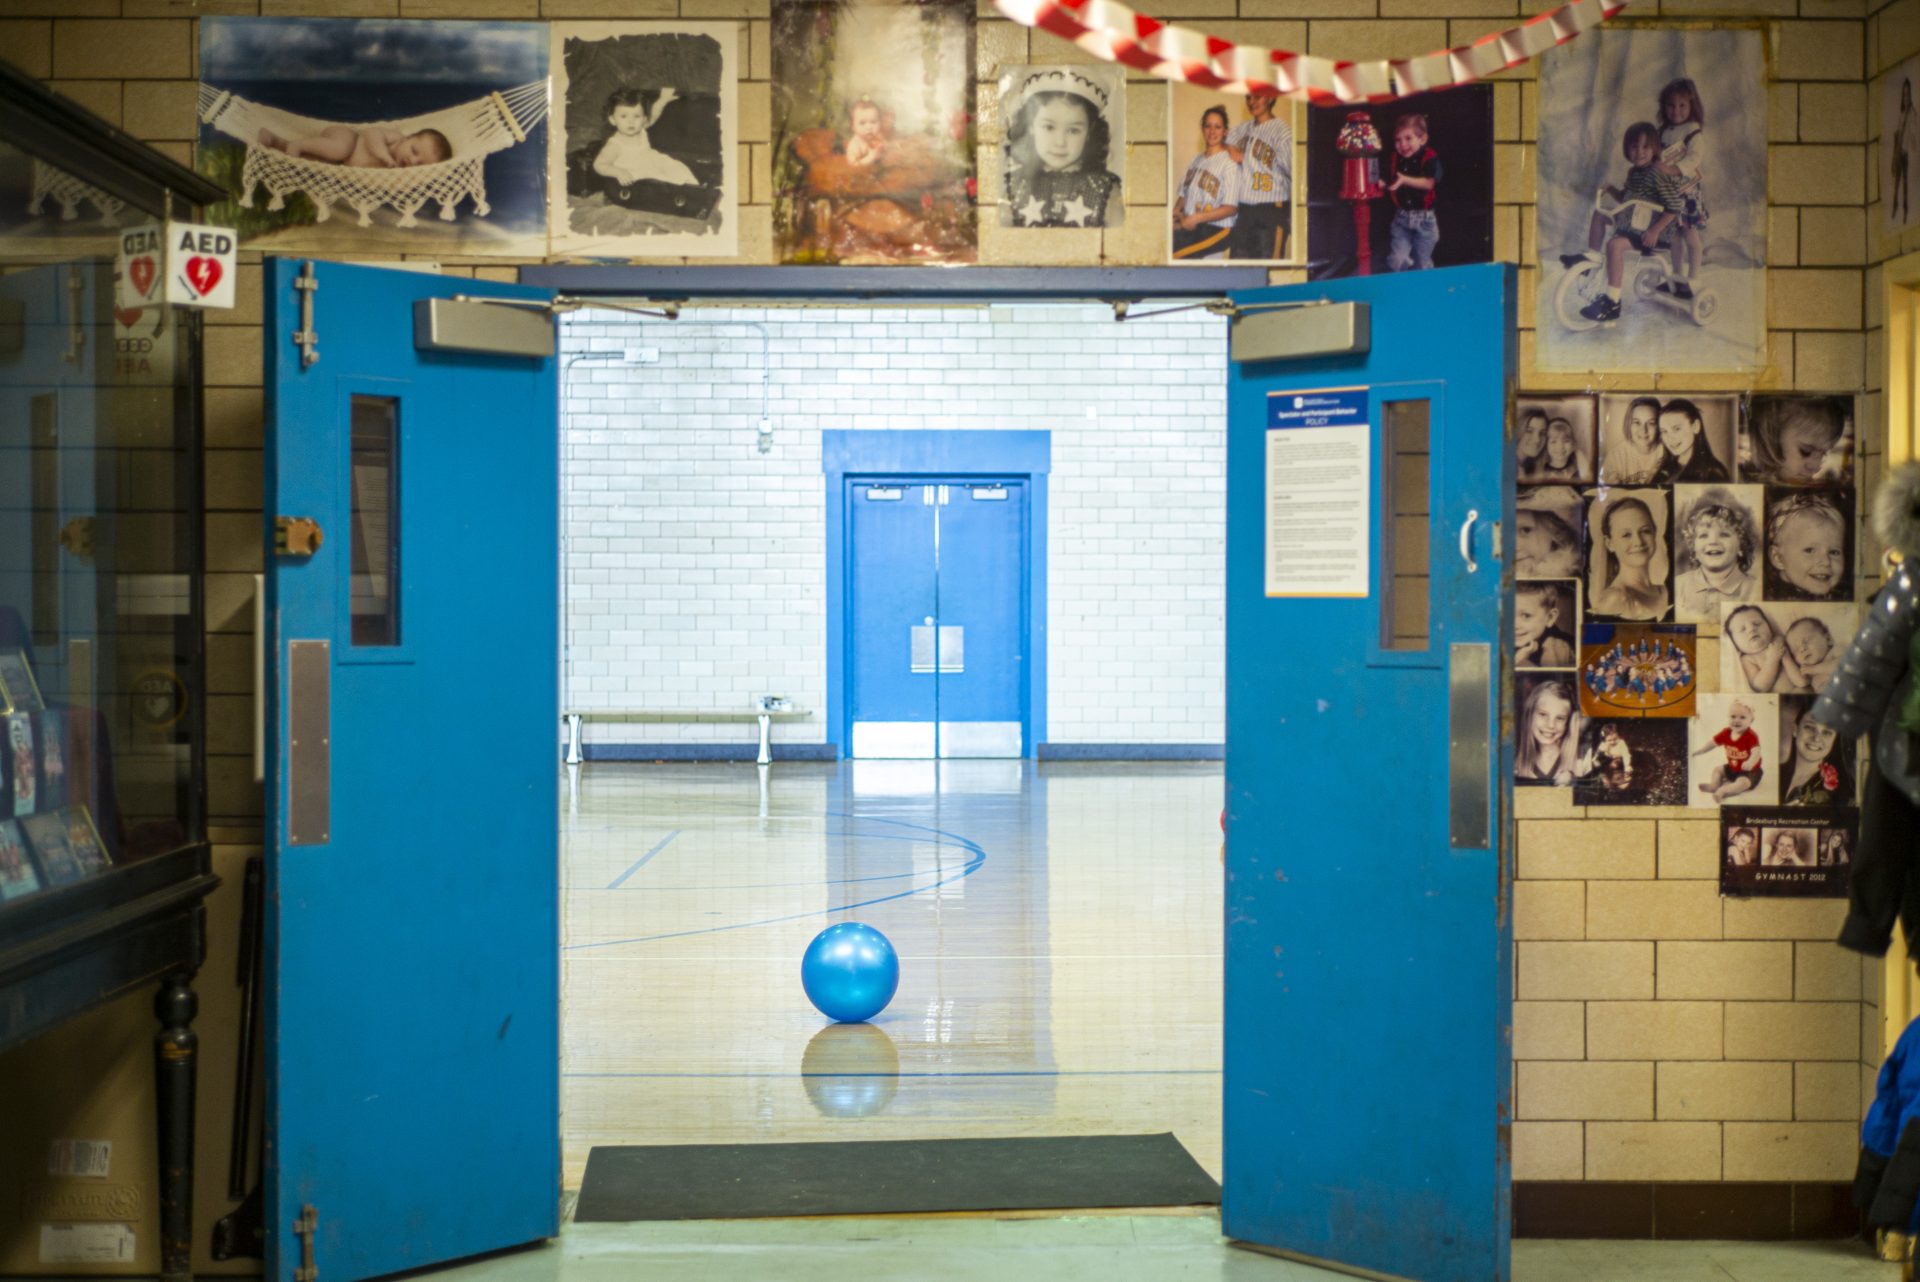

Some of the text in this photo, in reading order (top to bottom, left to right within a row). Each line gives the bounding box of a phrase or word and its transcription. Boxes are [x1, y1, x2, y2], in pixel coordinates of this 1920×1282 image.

[179, 231, 232, 255] AED
[1755, 872, 1826, 881] GYMNAST 2012
